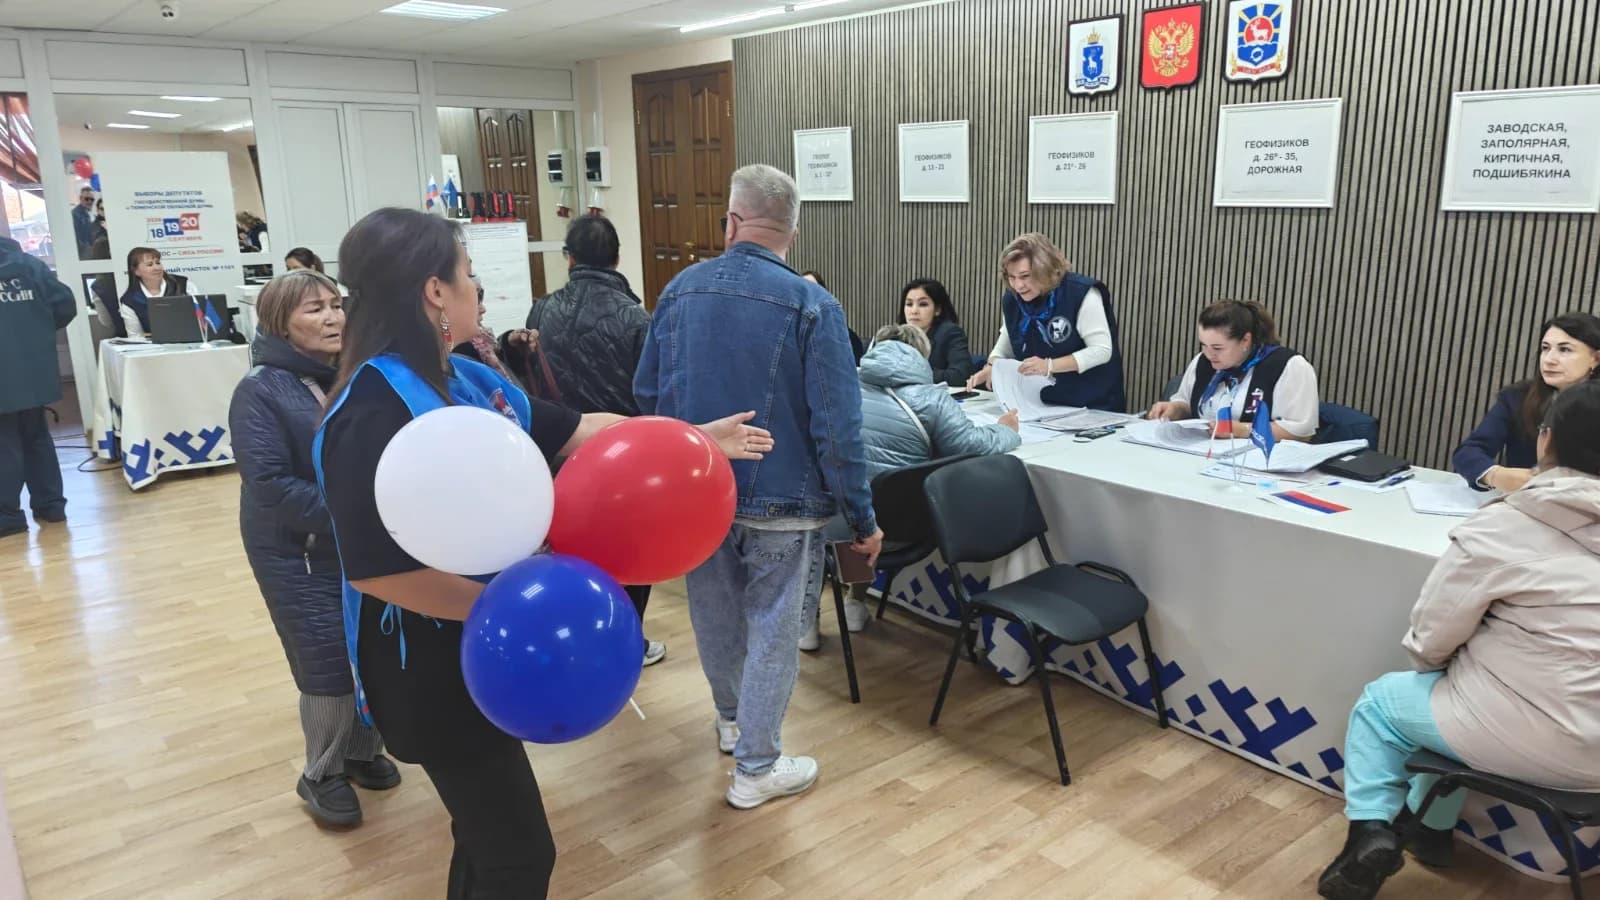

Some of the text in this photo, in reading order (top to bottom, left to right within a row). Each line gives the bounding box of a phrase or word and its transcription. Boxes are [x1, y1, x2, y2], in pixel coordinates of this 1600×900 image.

[1487, 122, 1567, 135] ЗАВОДСКАЯ,
[1244, 138, 1310, 149] ГЕОФИЗИКОВ
[1480, 138, 1570, 149] ЗАПОЛЯРНАЯ,
[1483, 153, 1563, 165] КИРПИЧНАЯ,
[1247, 164, 1303, 176] ДОРОЖНАЯ
[1472, 168, 1571, 180] ПОДШИБЯКИНА
[150, 216, 198, 239] 18 19 20
